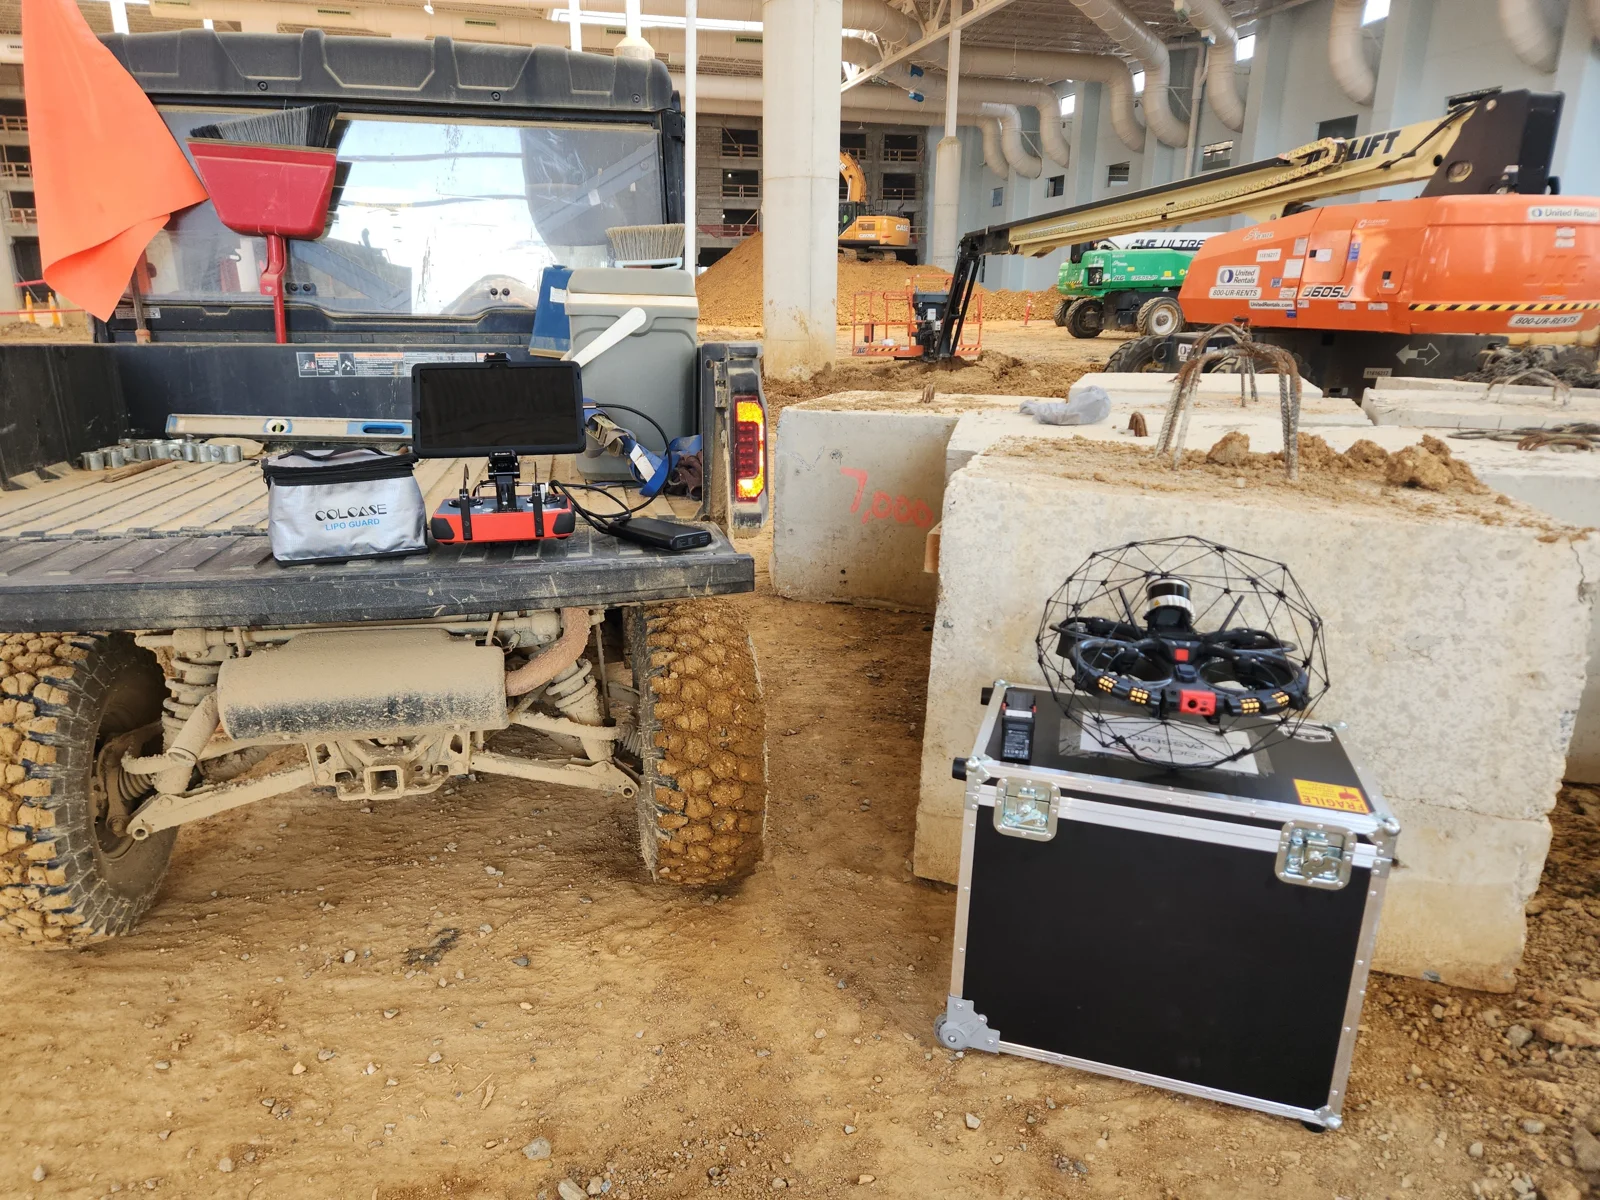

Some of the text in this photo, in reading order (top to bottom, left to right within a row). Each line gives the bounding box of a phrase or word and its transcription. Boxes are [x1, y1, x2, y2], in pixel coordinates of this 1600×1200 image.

[1345, 129, 1401, 162] LIFT
[1545, 208, 1572, 217] United
[1234, 269, 1256, 277] United
[1233, 276, 1256, 285] Rentals
[1211, 288, 1259, 298] 800-UR-RENTS
[1302, 286, 1354, 298] 860SJ
[1250, 301, 1294, 309] UnitedRentals.com
[1514, 315, 1579, 325] 800-UR-RENTS
[840, 467, 934, 528] 7,000
[315, 504, 387, 521] COLCASE
[325, 518, 380, 531] LIPO GUARD
[1303, 794, 1365, 811] FRAGILE
